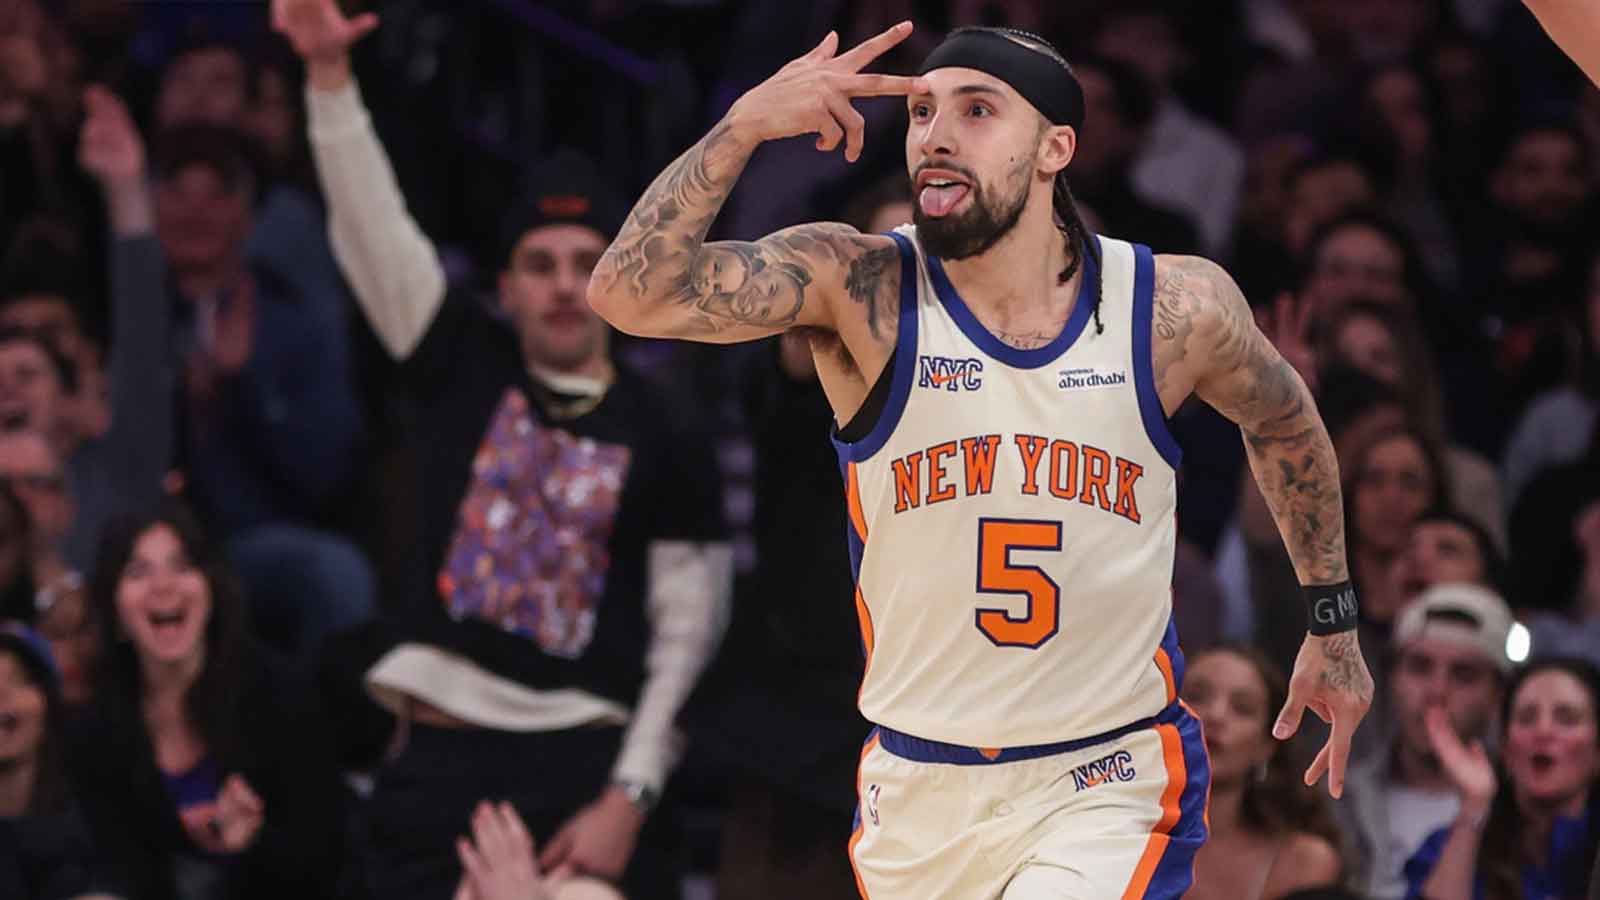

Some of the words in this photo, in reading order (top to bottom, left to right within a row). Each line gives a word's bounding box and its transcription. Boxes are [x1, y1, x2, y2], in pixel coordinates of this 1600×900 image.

[919, 356, 983, 391] NYC
[1058, 377, 1085, 389] abu
[1087, 371, 1126, 386] dhabi
[891, 434, 1001, 514] NEW
[1015, 434, 1144, 524] YORK
[975, 517, 1063, 650] 5
[1070, 750, 1136, 792] NYC
